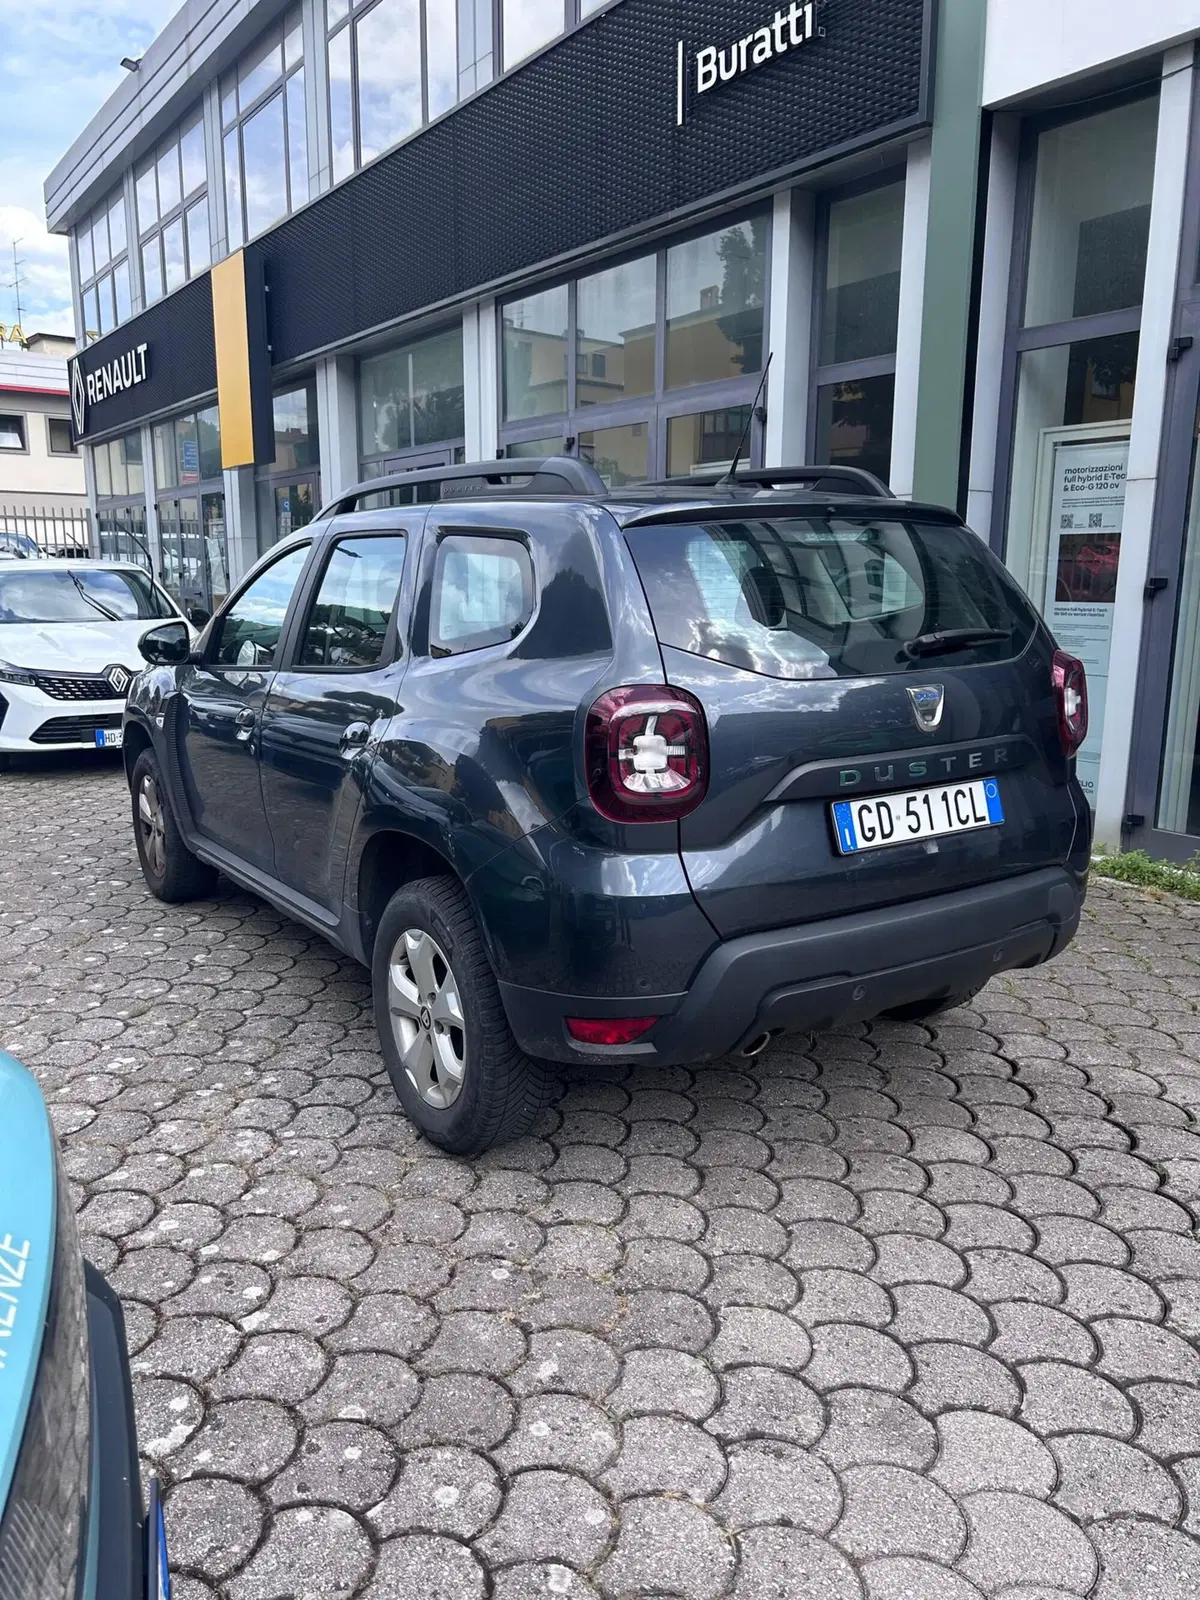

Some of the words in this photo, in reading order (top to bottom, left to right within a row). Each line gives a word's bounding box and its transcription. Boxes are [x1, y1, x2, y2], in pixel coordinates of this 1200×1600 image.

[696, 0, 813, 94] Buratti
[86, 342, 147, 406] RENAULT
[1064, 463, 1123, 475] motorizzazioni
[1064, 475, 1077, 483] full
[1077, 473, 1103, 484] hybrid
[1104, 472, 1127, 481] E-Tec
[1070, 483, 1094, 492] Eco-G
[1095, 482, 1108, 490] 120
[839, 748, 1009, 787] DUSTER
[857, 800, 895, 843] GD
[905, 787, 986, 834] 511CL
